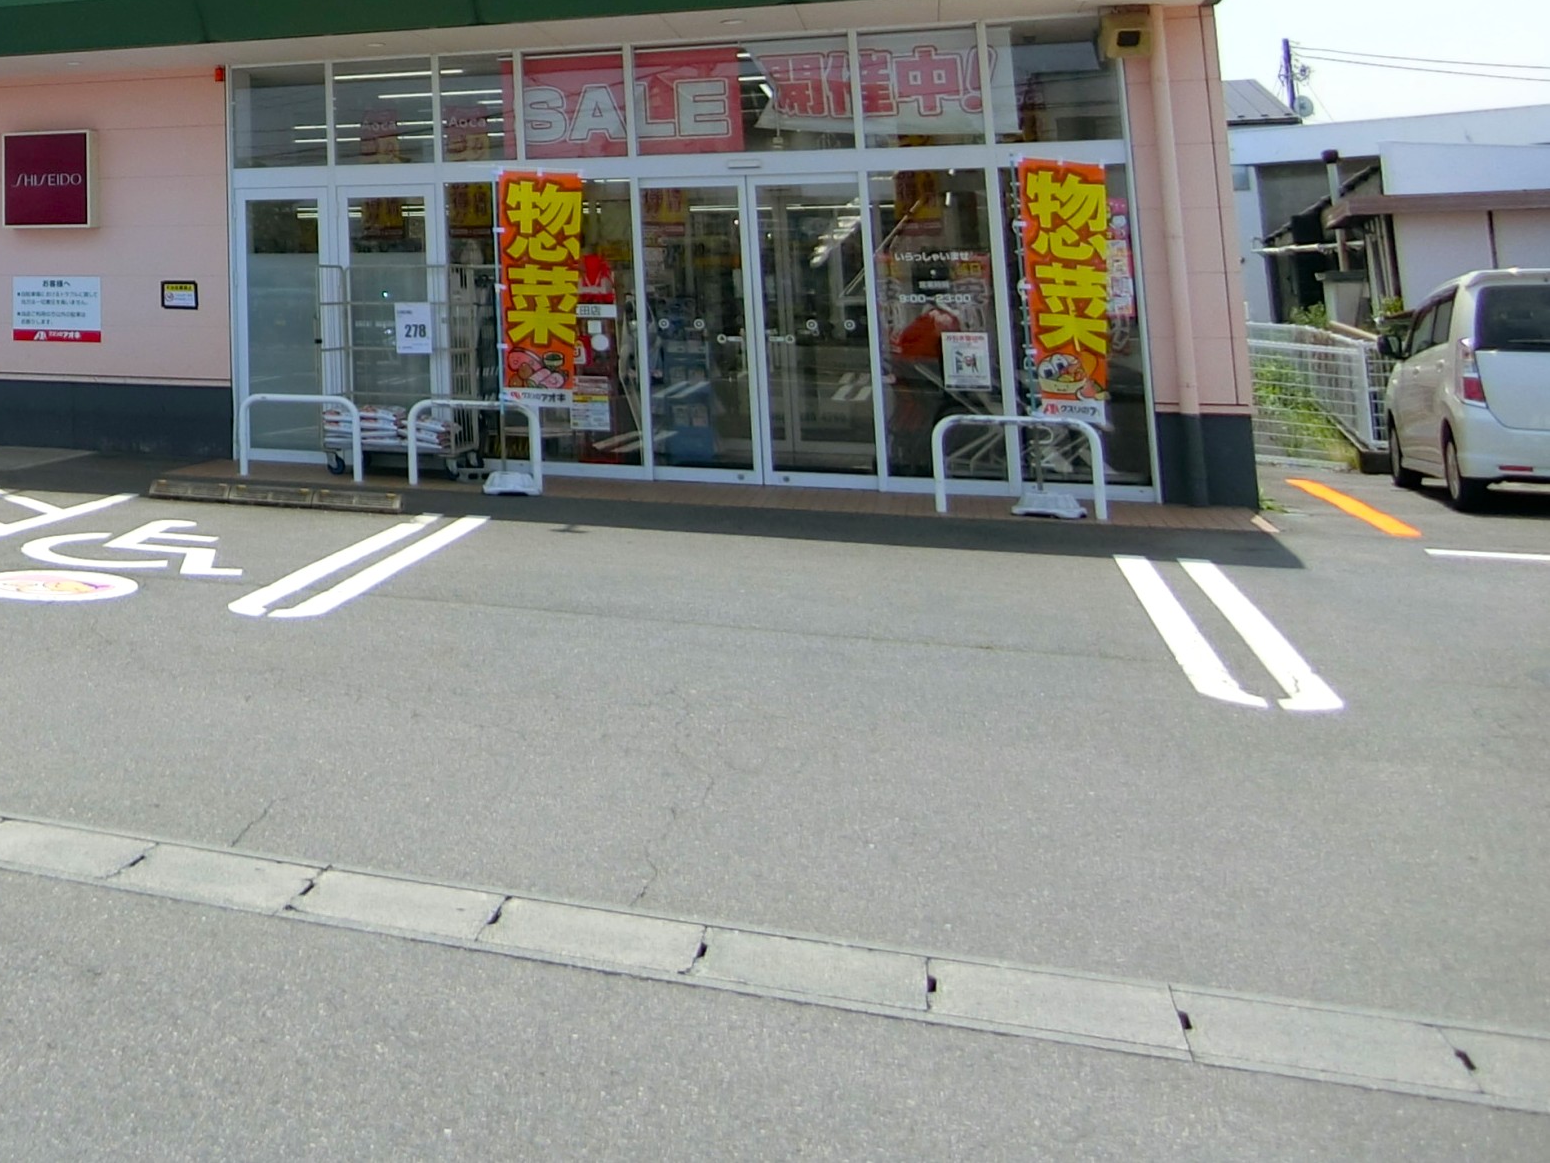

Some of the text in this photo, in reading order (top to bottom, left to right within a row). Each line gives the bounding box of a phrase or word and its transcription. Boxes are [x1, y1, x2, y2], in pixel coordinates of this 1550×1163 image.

[523, 78, 730, 144] SALE
[450, 117, 487, 128] Aoca
[13, 173, 82, 187] SHISEIDO
[506, 180, 582, 344] 惣菜
[894, 252, 970, 262] いらっしゃいませ
[1026, 171, 1107, 354] 惣菜
[404, 324, 427, 338] 278
[1061, 405, 1098, 417] クスリのア
